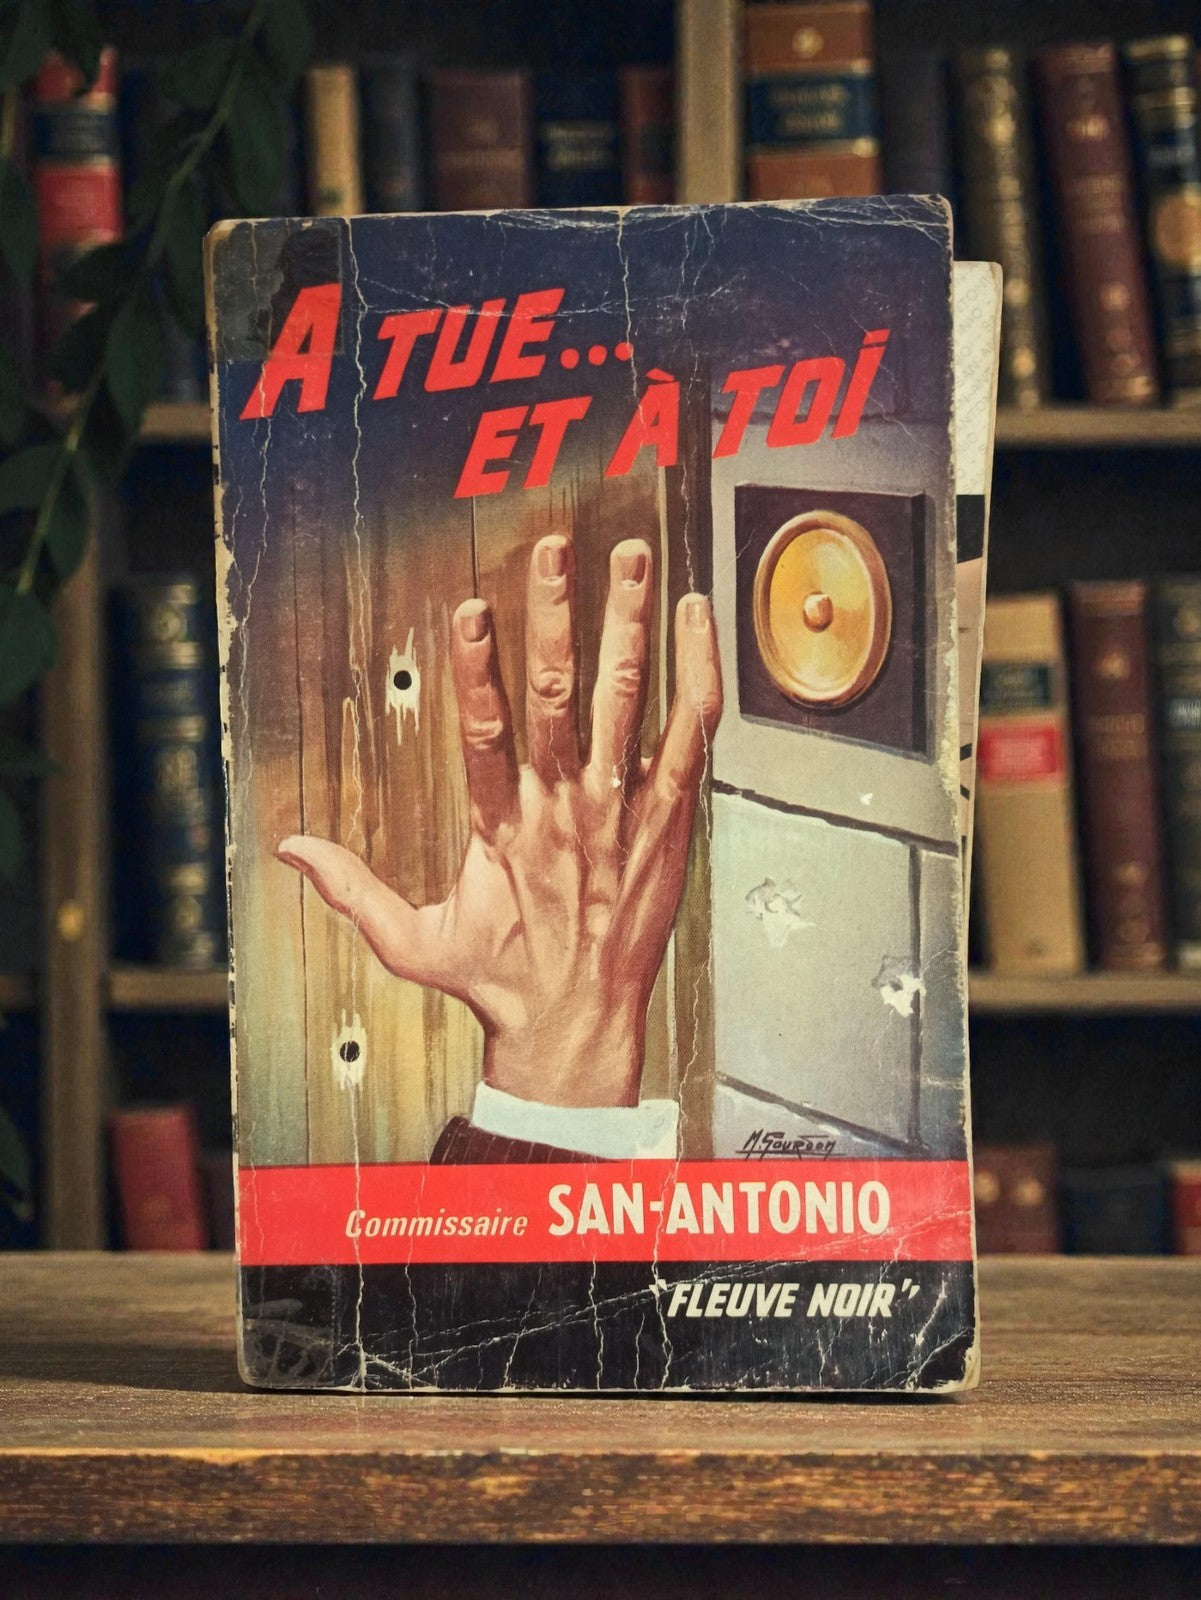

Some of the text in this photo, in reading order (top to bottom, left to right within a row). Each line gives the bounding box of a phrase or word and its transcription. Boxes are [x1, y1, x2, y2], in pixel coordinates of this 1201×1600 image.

[241, 283, 634, 420] A TUE...
[453, 396, 592, 499] ET
[604, 367, 681, 480] À
[345, 1180, 891, 1239] Commissaire SAN-ANTONIO
